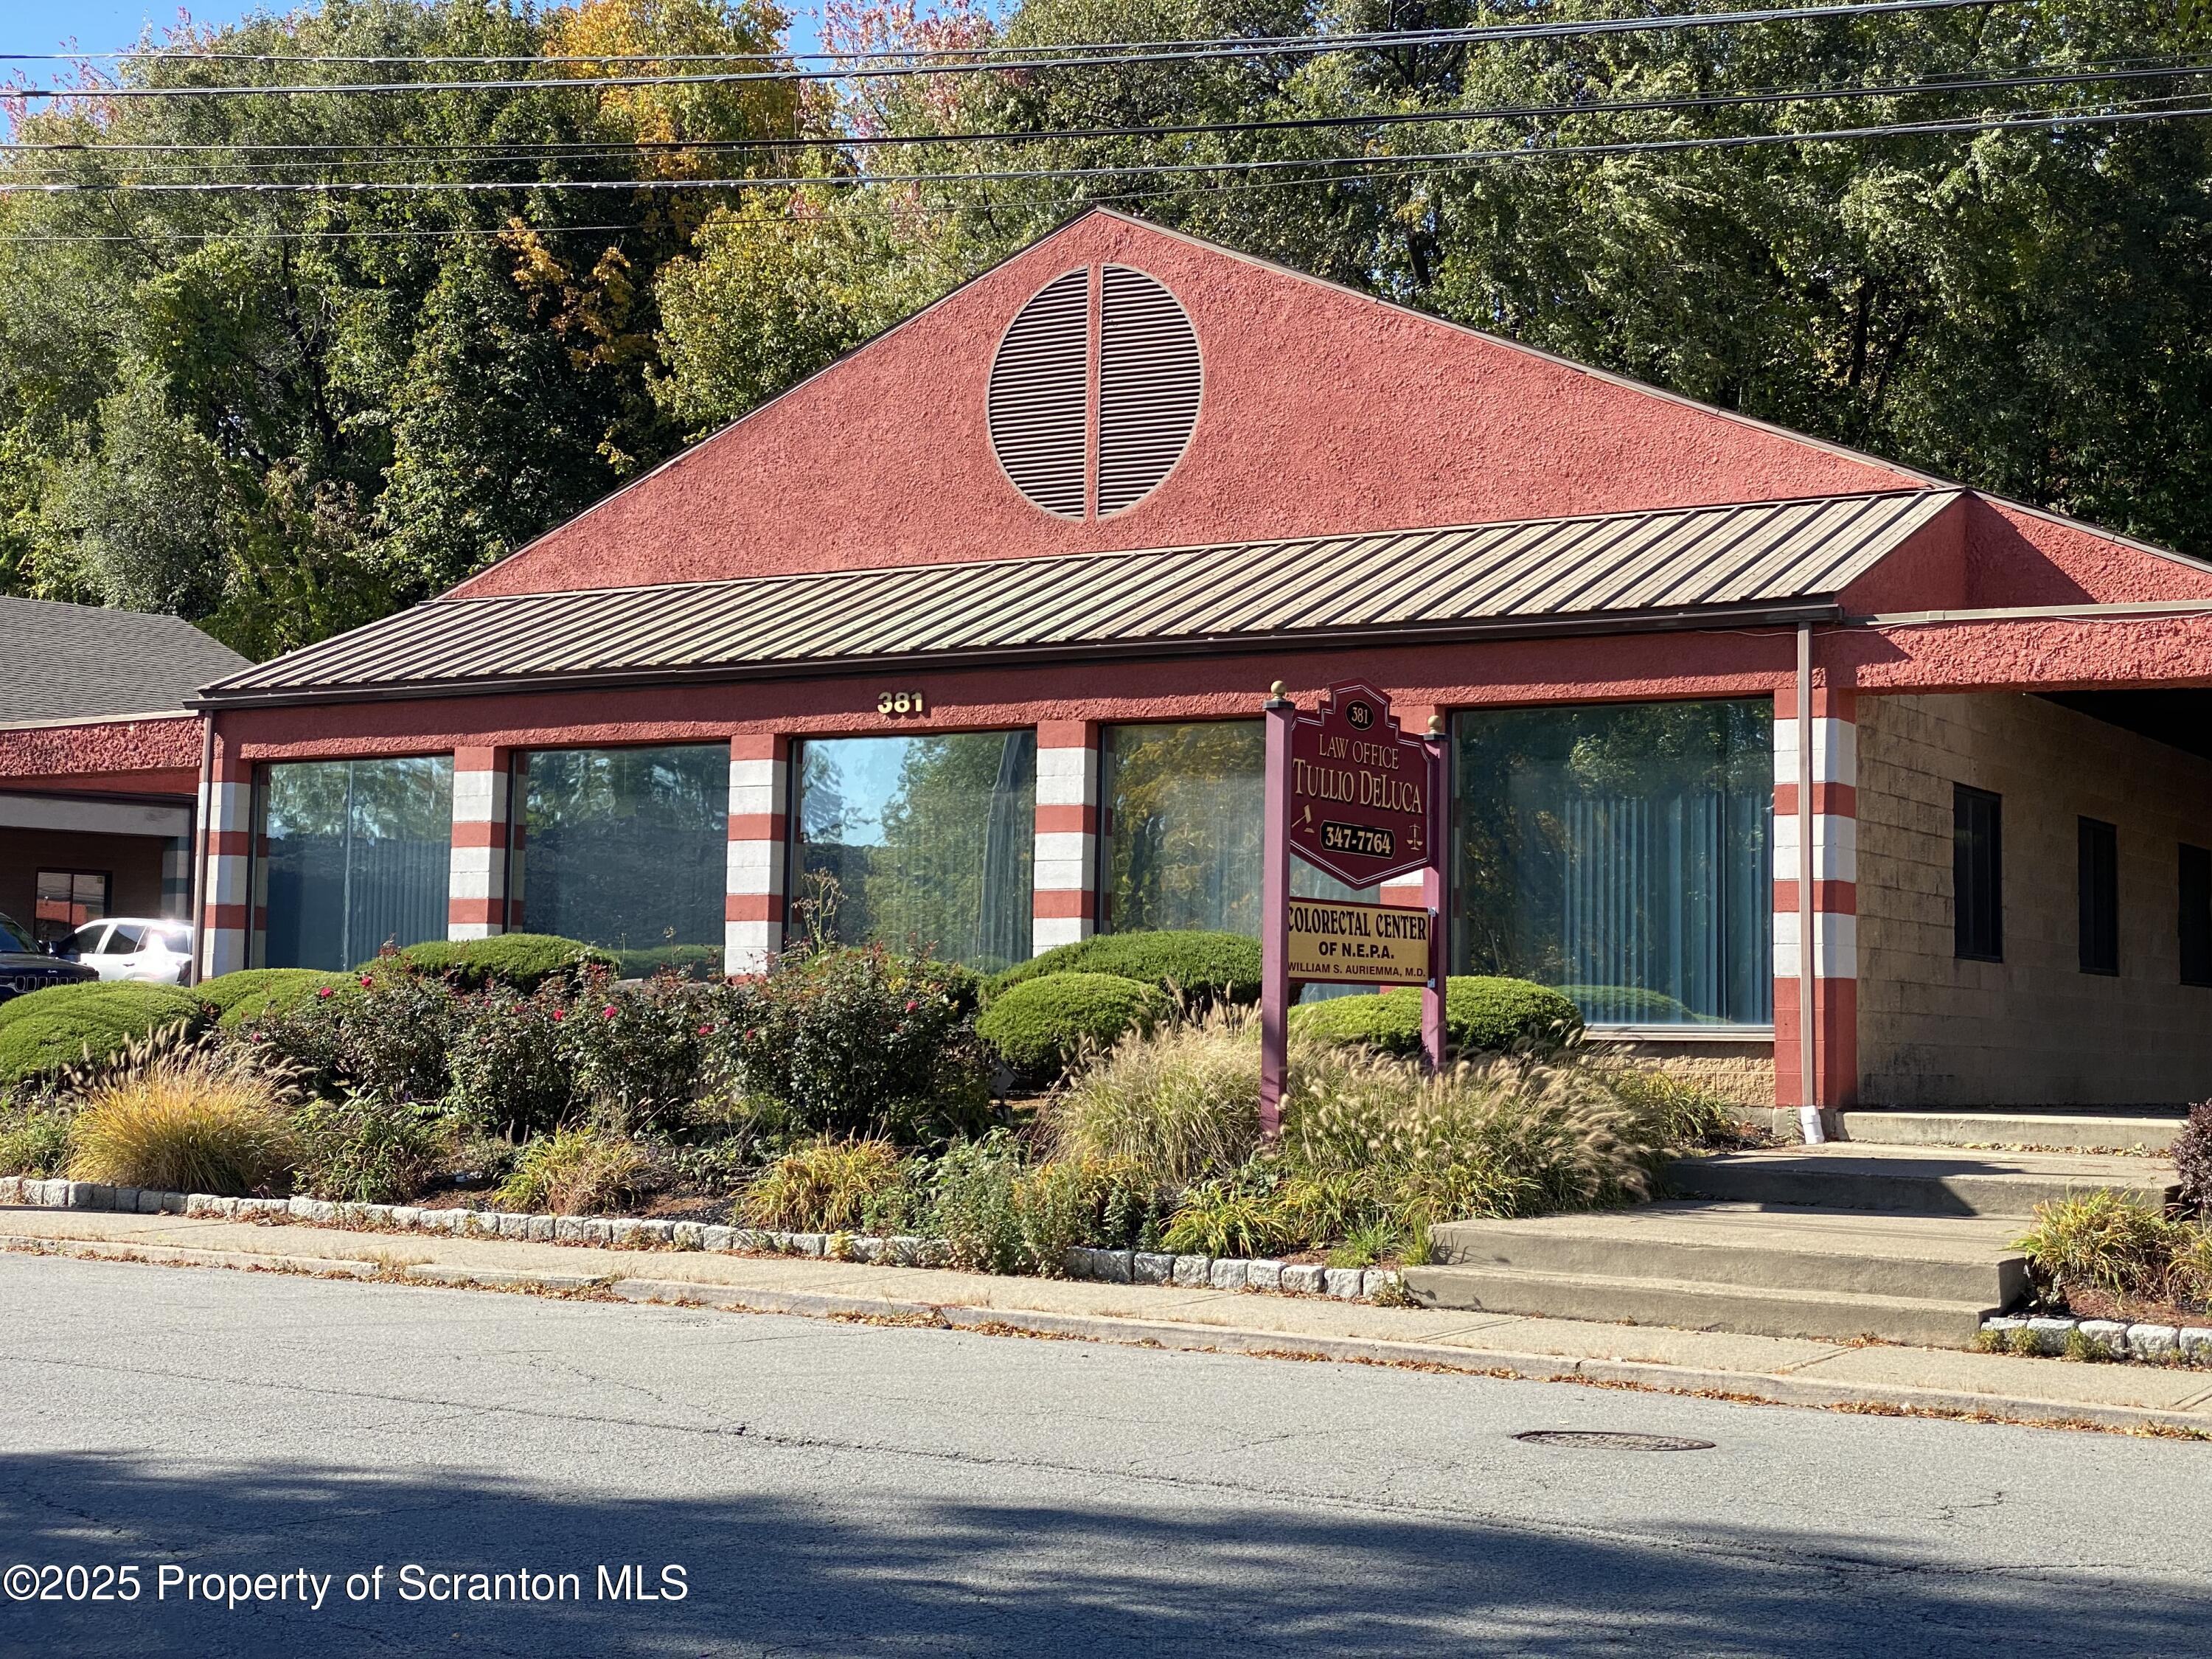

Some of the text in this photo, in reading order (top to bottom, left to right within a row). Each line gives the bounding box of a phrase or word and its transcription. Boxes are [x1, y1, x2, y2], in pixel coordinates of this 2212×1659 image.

[877, 692, 922, 714] 381
[1351, 706, 1368, 724] 381
[1319, 734, 1399, 770] LAW OFFICE
[1293, 758, 1354, 802] TULLIO
[1326, 827, 1391, 854] 347-7764
[1376, 914, 1426, 940] CENTER
[1318, 941, 1394, 959] OF N.E.P.A.
[1288, 962, 1426, 977] WILLIAM S. AURIEMMA, M.D.
